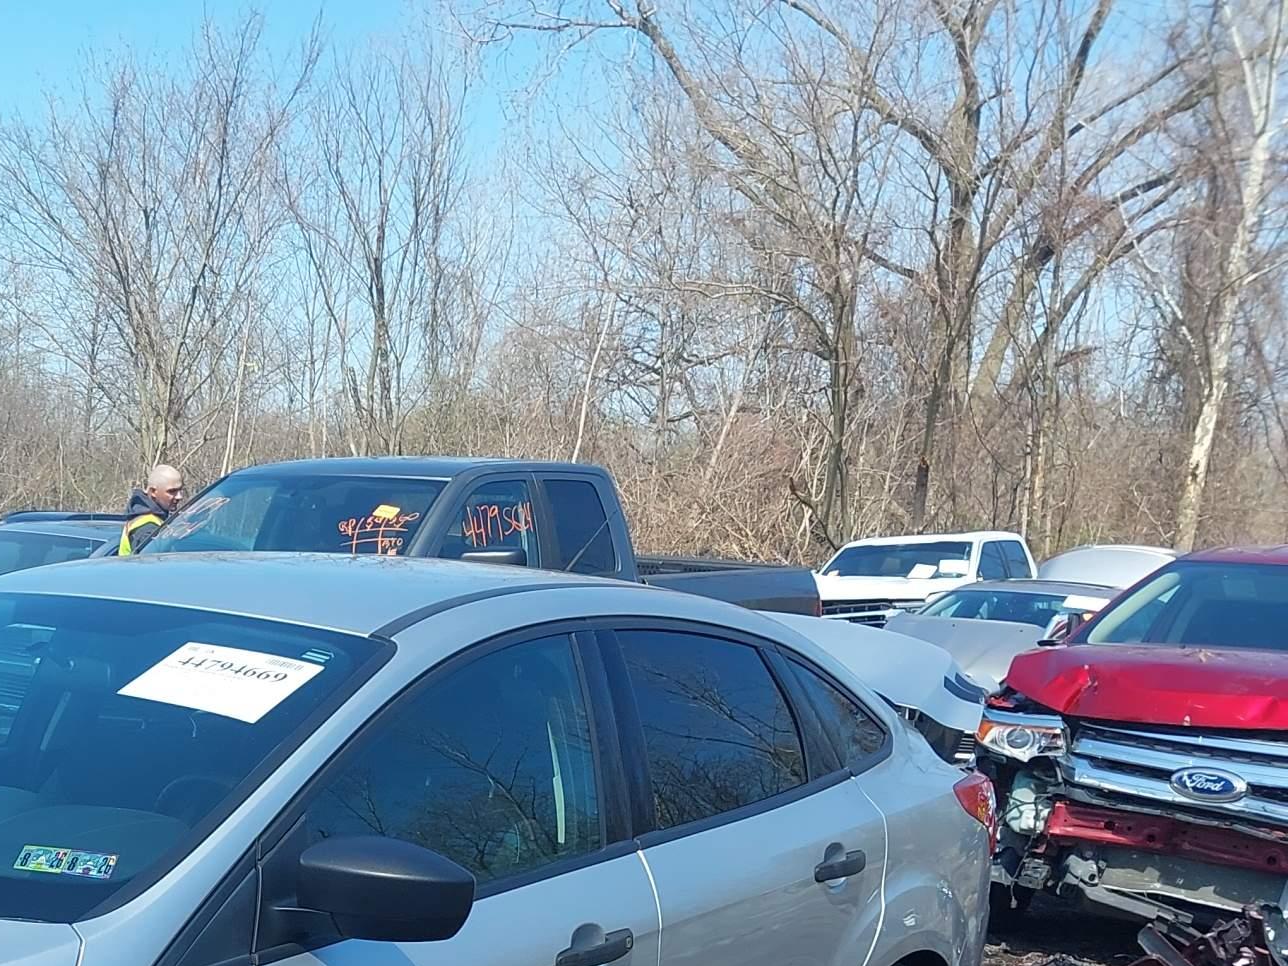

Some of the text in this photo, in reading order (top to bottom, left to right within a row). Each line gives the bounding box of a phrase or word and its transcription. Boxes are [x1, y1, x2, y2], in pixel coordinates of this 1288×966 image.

[178, 656, 289, 684] 44794669
[1182, 772, 1226, 792] Ford
[20, 852, 32, 867] 8
[67, 856, 79, 871] 8
